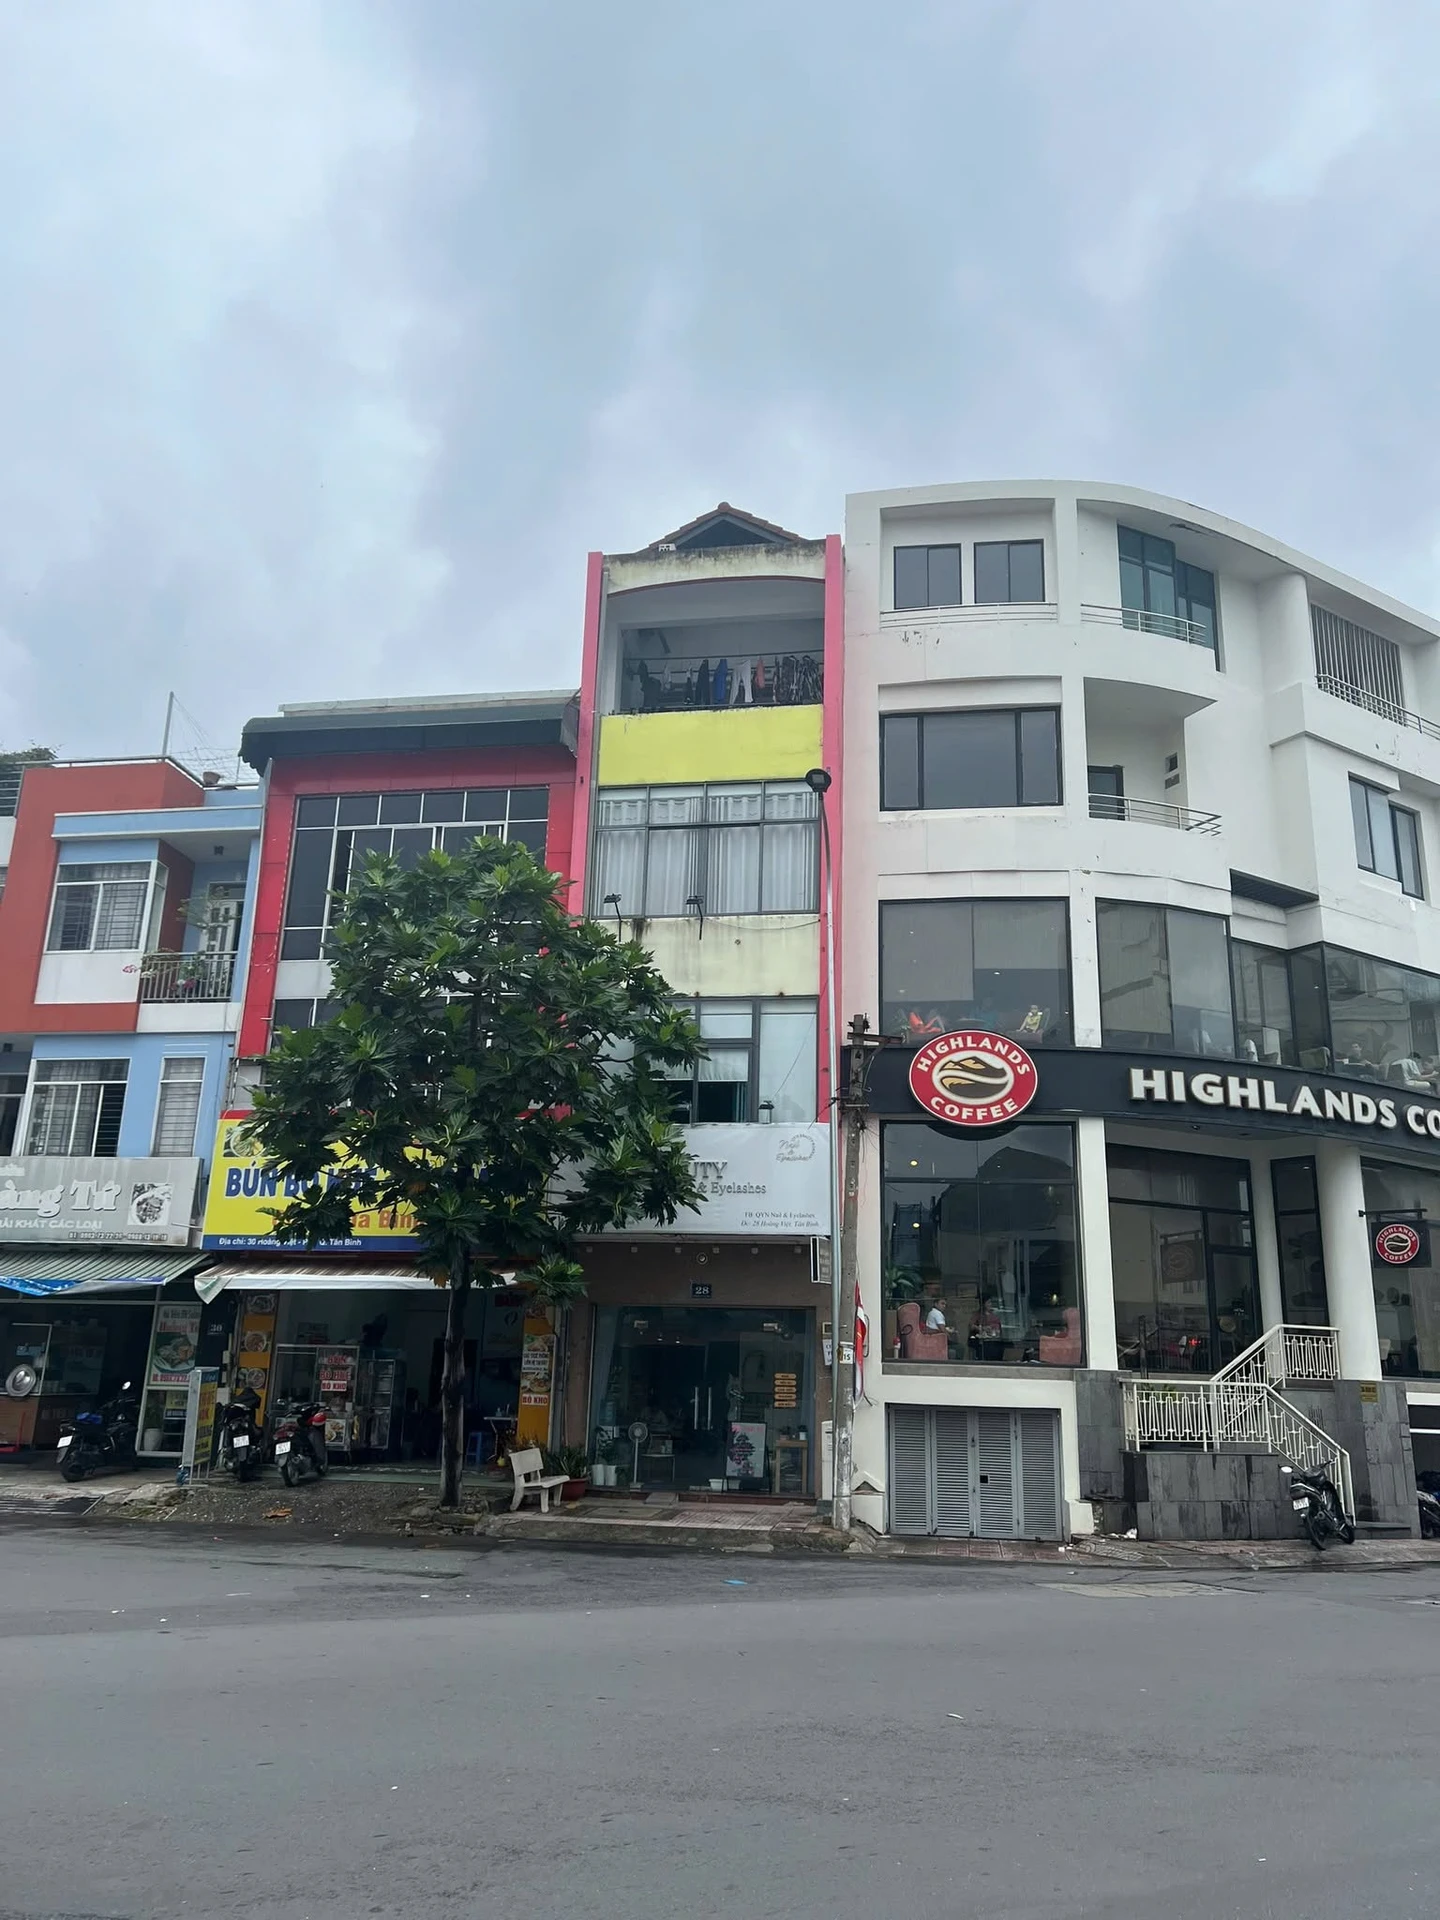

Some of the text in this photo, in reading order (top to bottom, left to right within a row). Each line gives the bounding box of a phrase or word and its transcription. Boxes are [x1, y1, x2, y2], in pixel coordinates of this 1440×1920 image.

[917, 1036, 1030, 1075] HIGHLANDS
[1129, 1067, 1397, 1129] HIGHLANDS
[930, 1096, 1018, 1120] COFFEE
[225, 1160, 278, 1197] BÚN
[711, 1181, 767, 1197] Eyelashes
[15, 1218, 46, 1229] KHÁT
[48, 1218, 75, 1229] CÁC
[76, 1220, 103, 1232] LOẠI
[219, 1237, 231, 1246] Địa
[247, 1237, 257, 1245] 30
[329, 1238, 343, 1246] Tân
[344, 1237, 362, 1246] Bình
[1379, 1227, 1417, 1244] HIGHLANDS
[1384, 1251, 1413, 1261] COFFEE
[695, 1286, 710, 1295] 28
[533, 1396, 548, 1405] KHO
